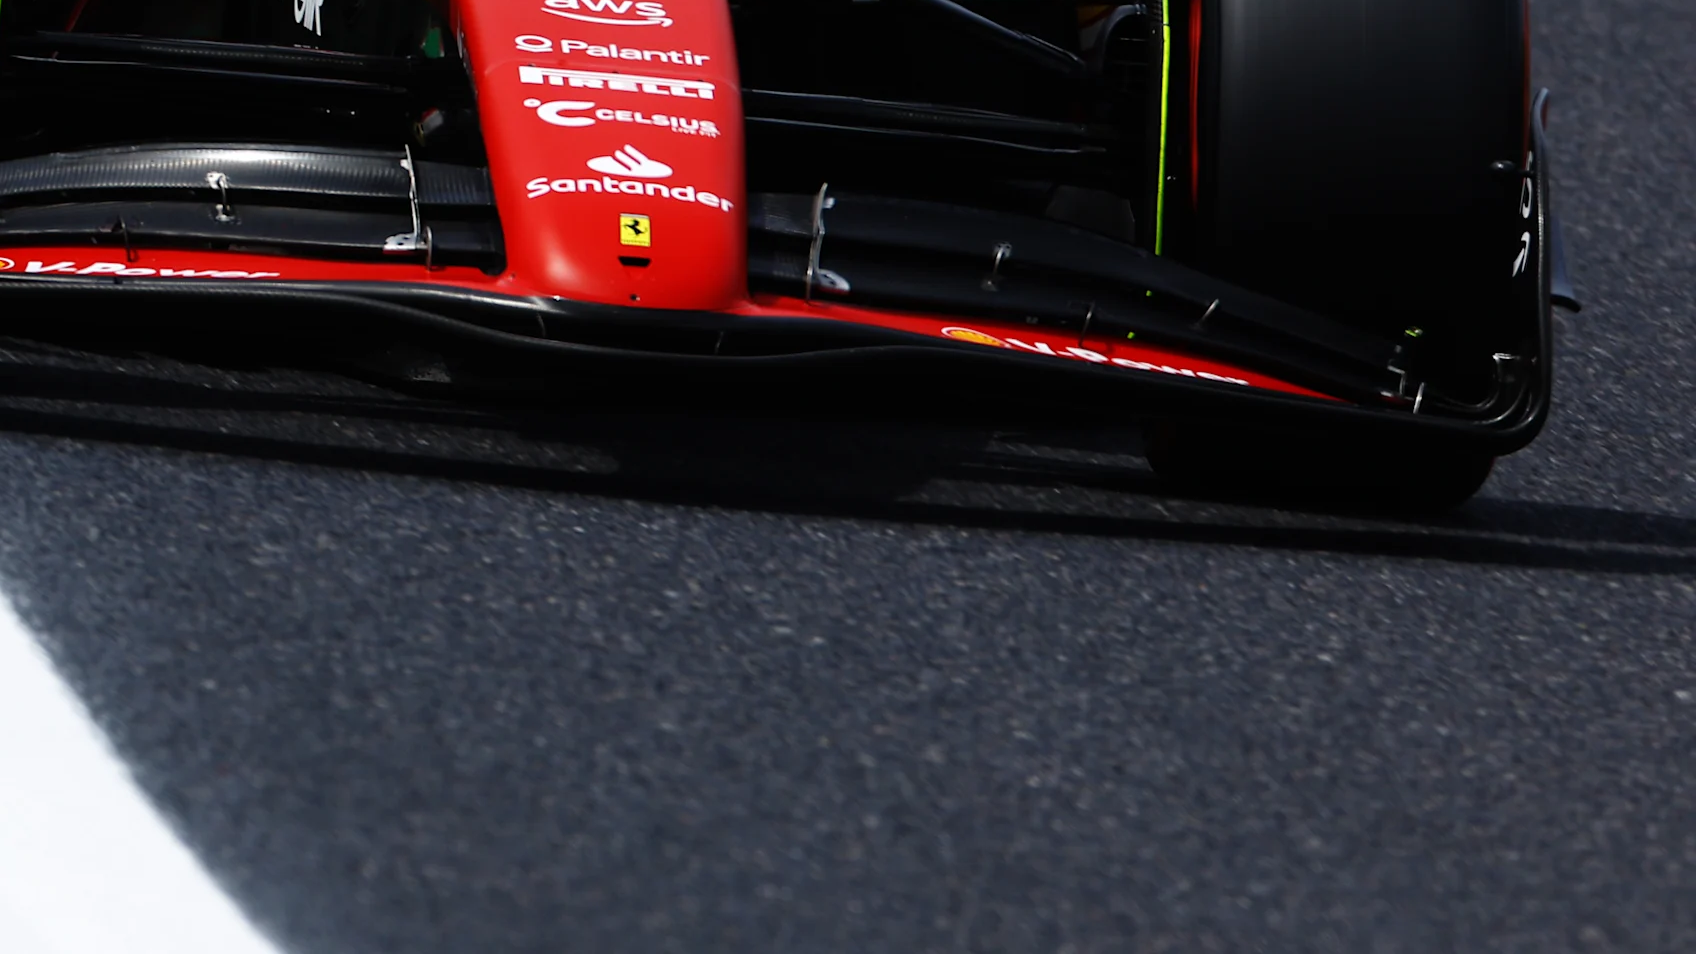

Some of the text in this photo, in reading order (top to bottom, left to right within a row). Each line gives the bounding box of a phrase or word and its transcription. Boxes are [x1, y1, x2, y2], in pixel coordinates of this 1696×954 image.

[560, 39, 711, 66] Palantir
[518, 65, 716, 100] PIRELLI
[595, 108, 720, 135] CELSIUS
[526, 176, 735, 213] Santander
[24, 261, 280, 278] V-Power
